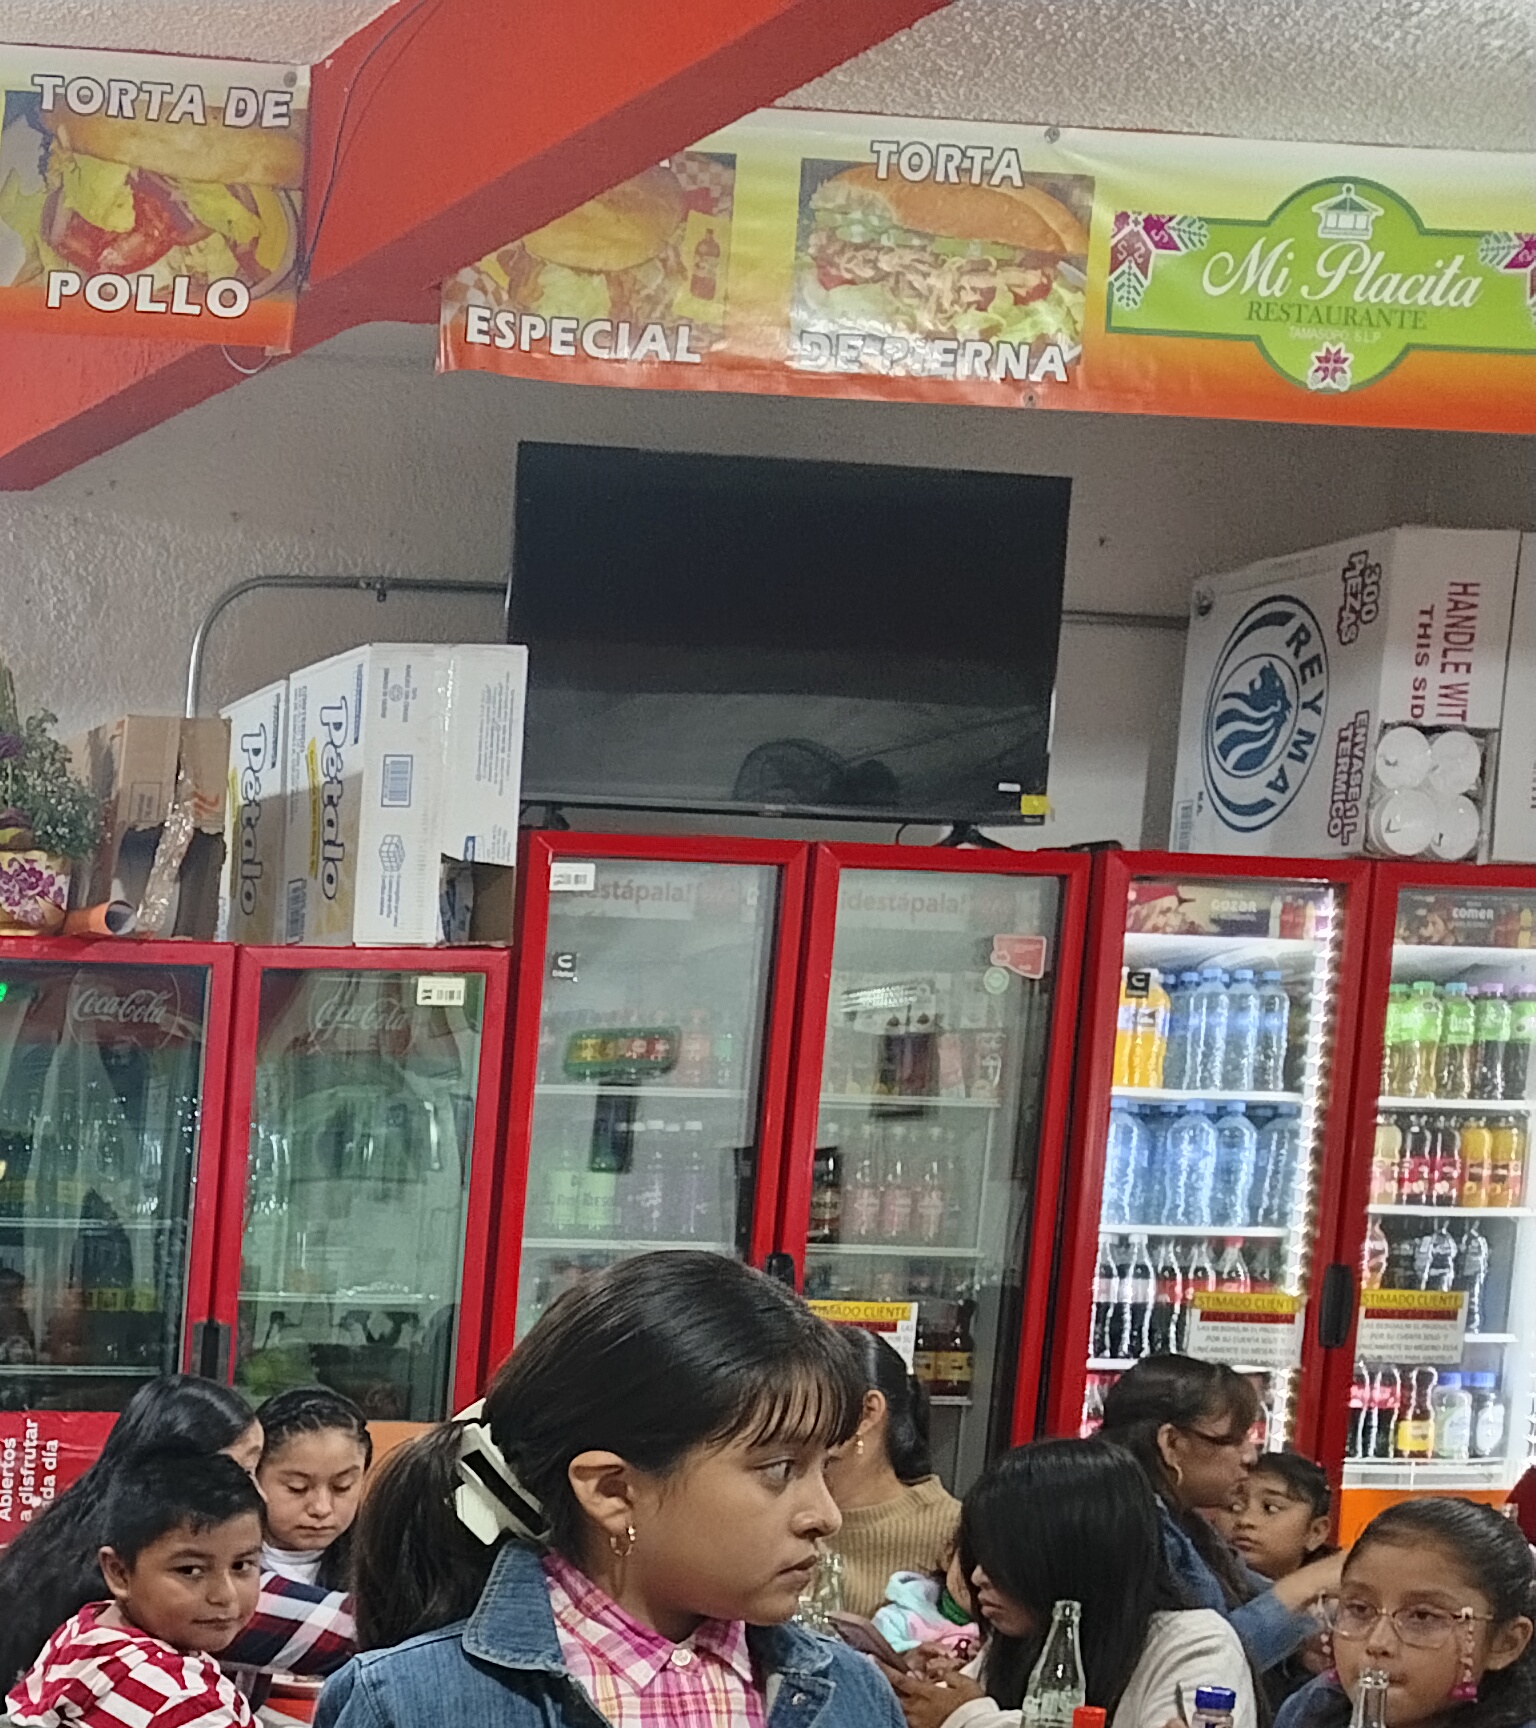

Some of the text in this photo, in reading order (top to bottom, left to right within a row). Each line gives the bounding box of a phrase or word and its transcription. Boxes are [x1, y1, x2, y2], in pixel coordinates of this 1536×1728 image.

[31, 73, 295, 130] TORTA DE
[870, 139, 1026, 189] TORTA
[45, 270, 253, 321] POLLO
[1200, 236, 1486, 310] Mi Placita
[464, 304, 703, 365] ESPECIAL
[1245, 300, 1429, 331] RESTAURANTE
[796, 332, 1071, 384] DE PIERNA
[1336, 549, 1368, 647] PIEZAS
[1358, 561, 1383, 626] 300
[1409, 602, 1436, 721] THIS SID
[1434, 581, 1482, 724] HANDLE WIT
[1265, 622, 1326, 796] REYMA
[1327, 721, 1356, 840] TERMICO
[17, 1418, 39, 1523] a disfrutar
